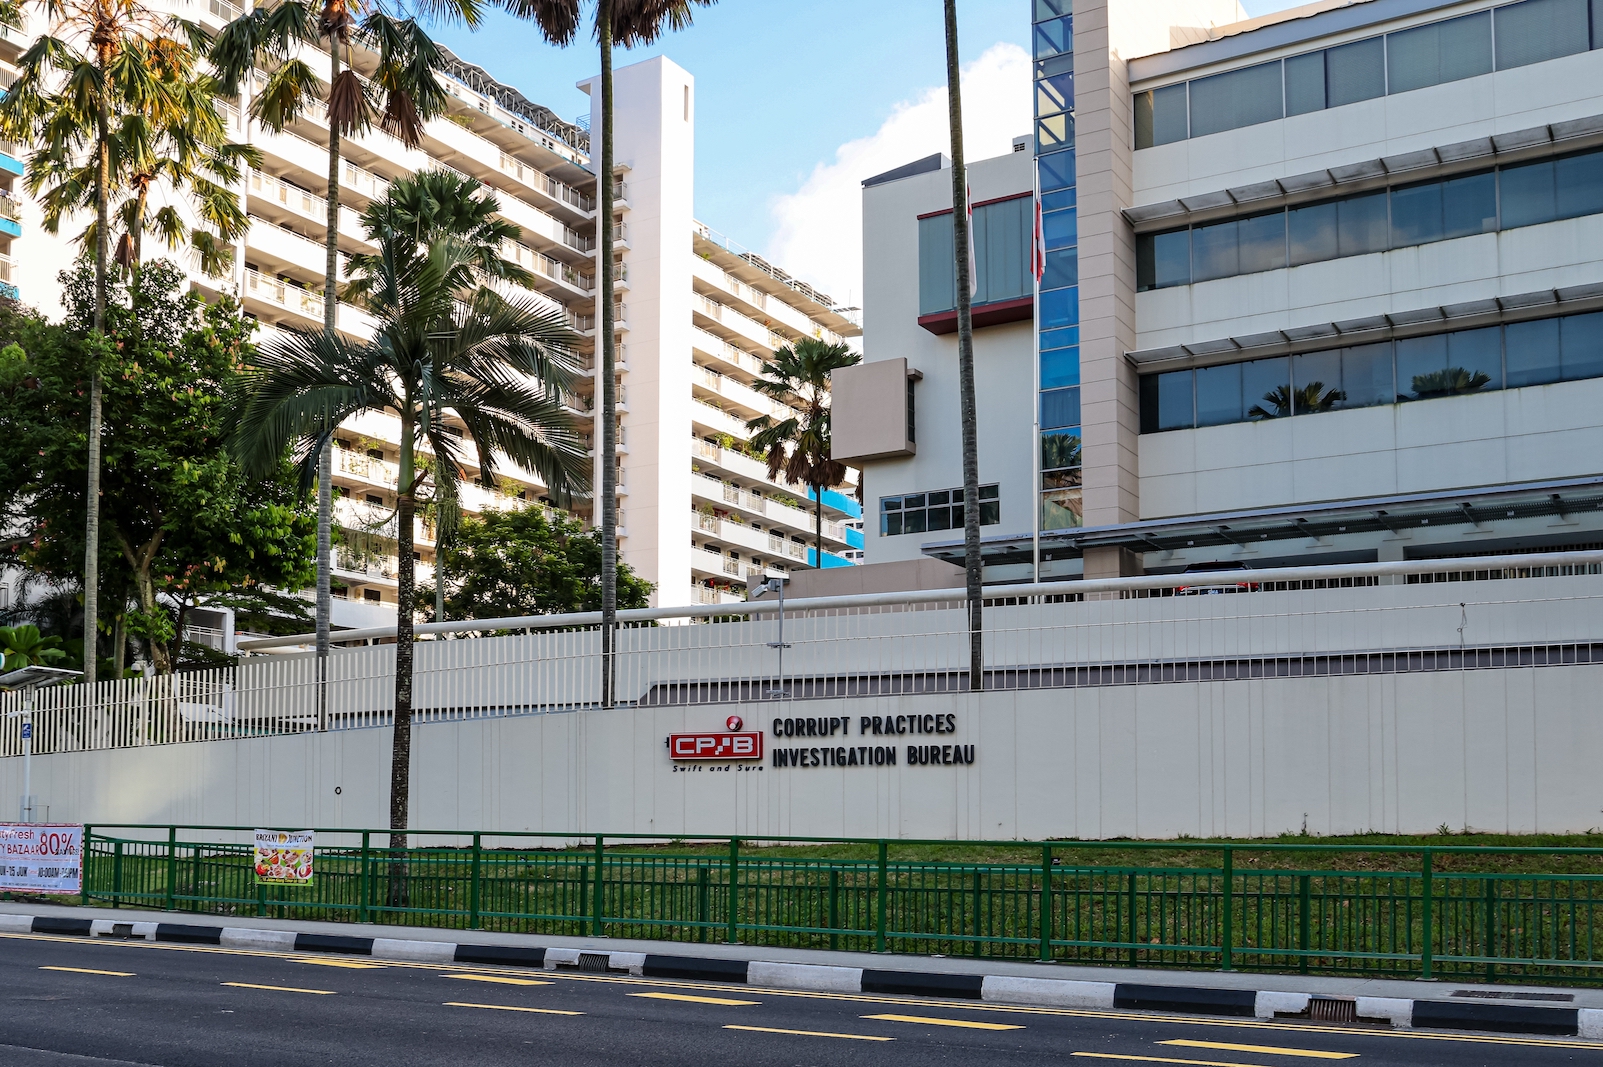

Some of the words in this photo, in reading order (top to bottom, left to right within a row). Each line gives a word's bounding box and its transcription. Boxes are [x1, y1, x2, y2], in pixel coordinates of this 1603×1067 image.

[773, 717, 850, 737] CORRUPT
[860, 713, 956, 735] PRACTICES
[773, 746, 897, 767] INVESTIGATION
[907, 744, 975, 765] BUREAU
[672, 764, 703, 773] Swift
[709, 764, 731, 772] and
[737, 764, 764, 772] Sure
[7, 844, 40, 856] BAZAAR
[40, 833, 75, 855] 80%
